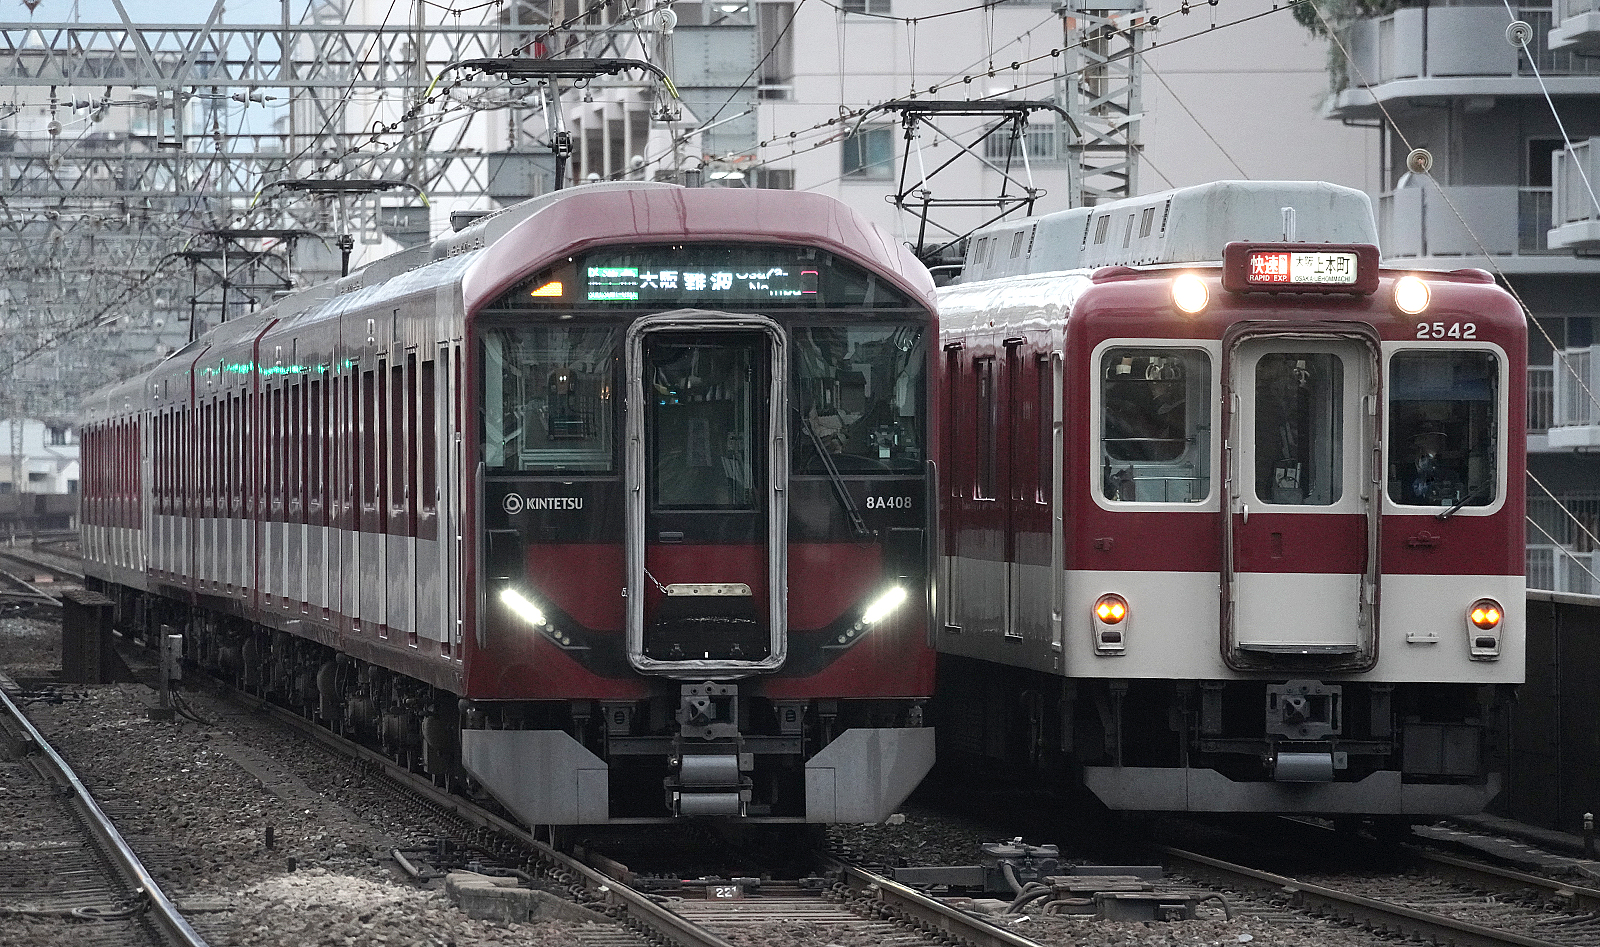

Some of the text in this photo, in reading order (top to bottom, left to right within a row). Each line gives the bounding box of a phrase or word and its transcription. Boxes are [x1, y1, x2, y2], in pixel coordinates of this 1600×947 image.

[1249, 274, 1288, 282] RAPID EXP.
[1416, 322, 1477, 339] 2542
[526, 497, 583, 510] KINTETSU
[866, 496, 913, 509] 8A408
